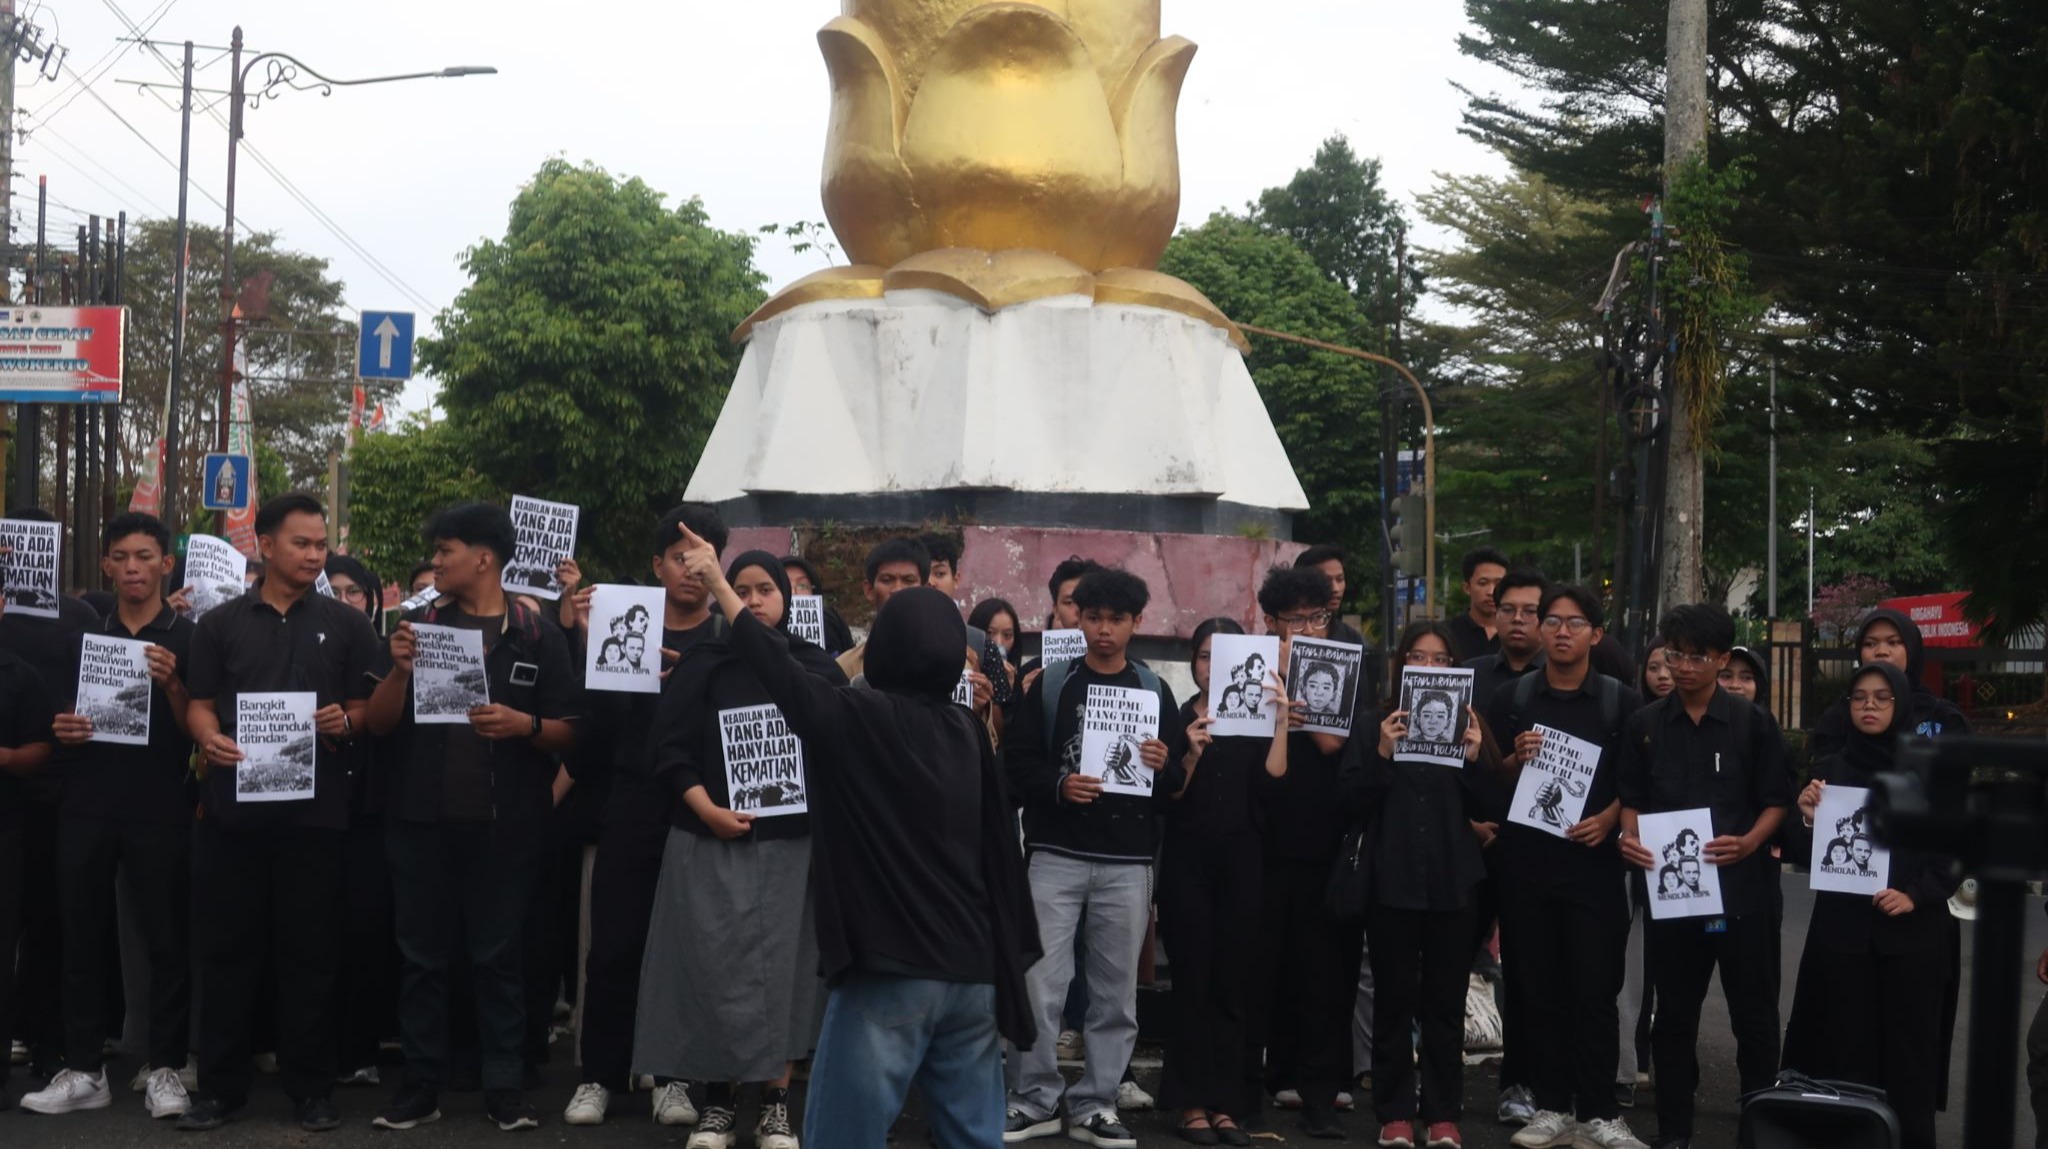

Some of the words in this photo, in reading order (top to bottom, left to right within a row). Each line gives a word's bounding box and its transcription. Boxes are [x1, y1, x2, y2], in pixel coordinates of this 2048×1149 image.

[0, 327, 33, 340] SAT
[0, 357, 88, 371] WOKERTO
[514, 500, 550, 515] KEADILAN
[0, 523, 28, 534] ADILAN
[514, 510, 546, 530] YANG
[548, 518, 573, 535] ADA
[0, 534, 25, 551] ANG
[28, 536, 54, 553] ADA
[190, 540, 228, 557] Bangkit
[0, 551, 54, 569] ANYALAH
[188, 550, 233, 568] melawan
[186, 568, 225, 582] ditindas
[187, 560, 209, 568] atau
[212, 562, 242, 581] tunduk
[796, 610, 819, 624] ADA
[1044, 635, 1082, 646] Bangkit
[85, 640, 126, 656] Bangkit
[84, 653, 133, 668] melawan
[442, 652, 480, 665] tunduk
[82, 664, 106, 675] atau
[109, 666, 148, 680] tunduk
[415, 660, 460, 672] ditindas
[596, 665, 630, 674] MENOLAK
[82, 673, 124, 688] ditindas
[1089, 686, 1128, 698] REBUT
[240, 700, 286, 712] Bangkit
[1088, 698, 1144, 711] HIDUPMU
[240, 712, 296, 722] melawan
[722, 710, 763, 726] KEADILAN
[764, 708, 782, 720] HAB
[1087, 709, 1117, 720] YANG
[1121, 712, 1156, 724] TELAH
[240, 724, 266, 733] atau
[268, 721, 312, 732] tunduk
[724, 722, 763, 744] YANG
[1086, 720, 1136, 734] TERCURI
[240, 733, 288, 744] ditindas
[727, 738, 796, 762] HANYALAH
[1544, 740, 1582, 760] DUPMU
[730, 756, 797, 787] KEMATIAN
[1559, 756, 1593, 776] TELAH
[1820, 866, 1856, 876] MENOLAK
[1860, 870, 1878, 878] LUPA
[1658, 892, 1690, 901] MENOLAK
